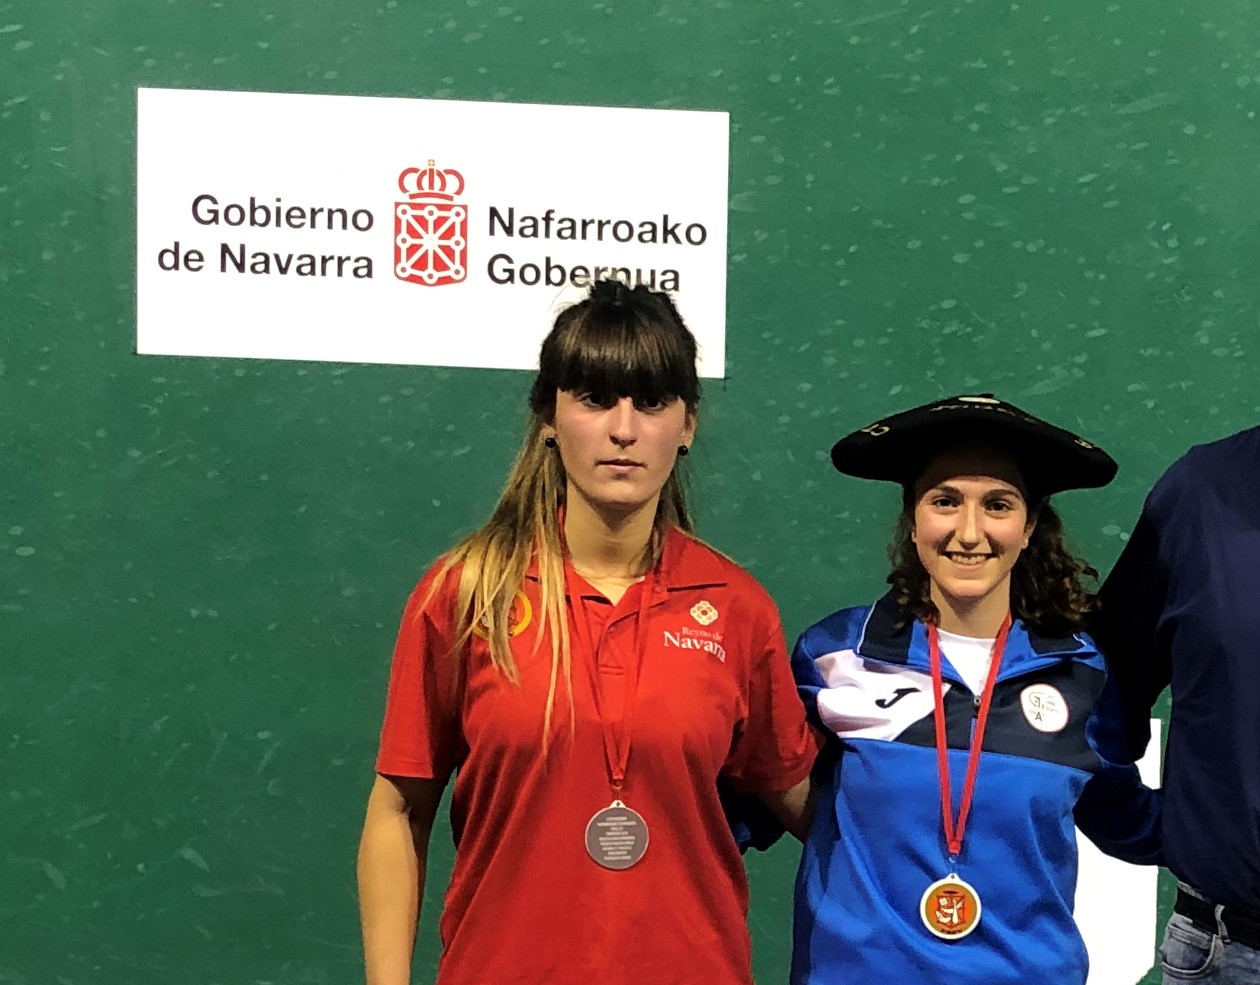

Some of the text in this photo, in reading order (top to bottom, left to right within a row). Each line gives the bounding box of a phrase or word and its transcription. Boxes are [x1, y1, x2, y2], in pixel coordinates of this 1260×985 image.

[191, 194, 375, 232] Gobierno
[488, 206, 708, 247] Nafarroako
[158, 241, 374, 279] de Navarra
[487, 253, 681, 292] Gobernua
